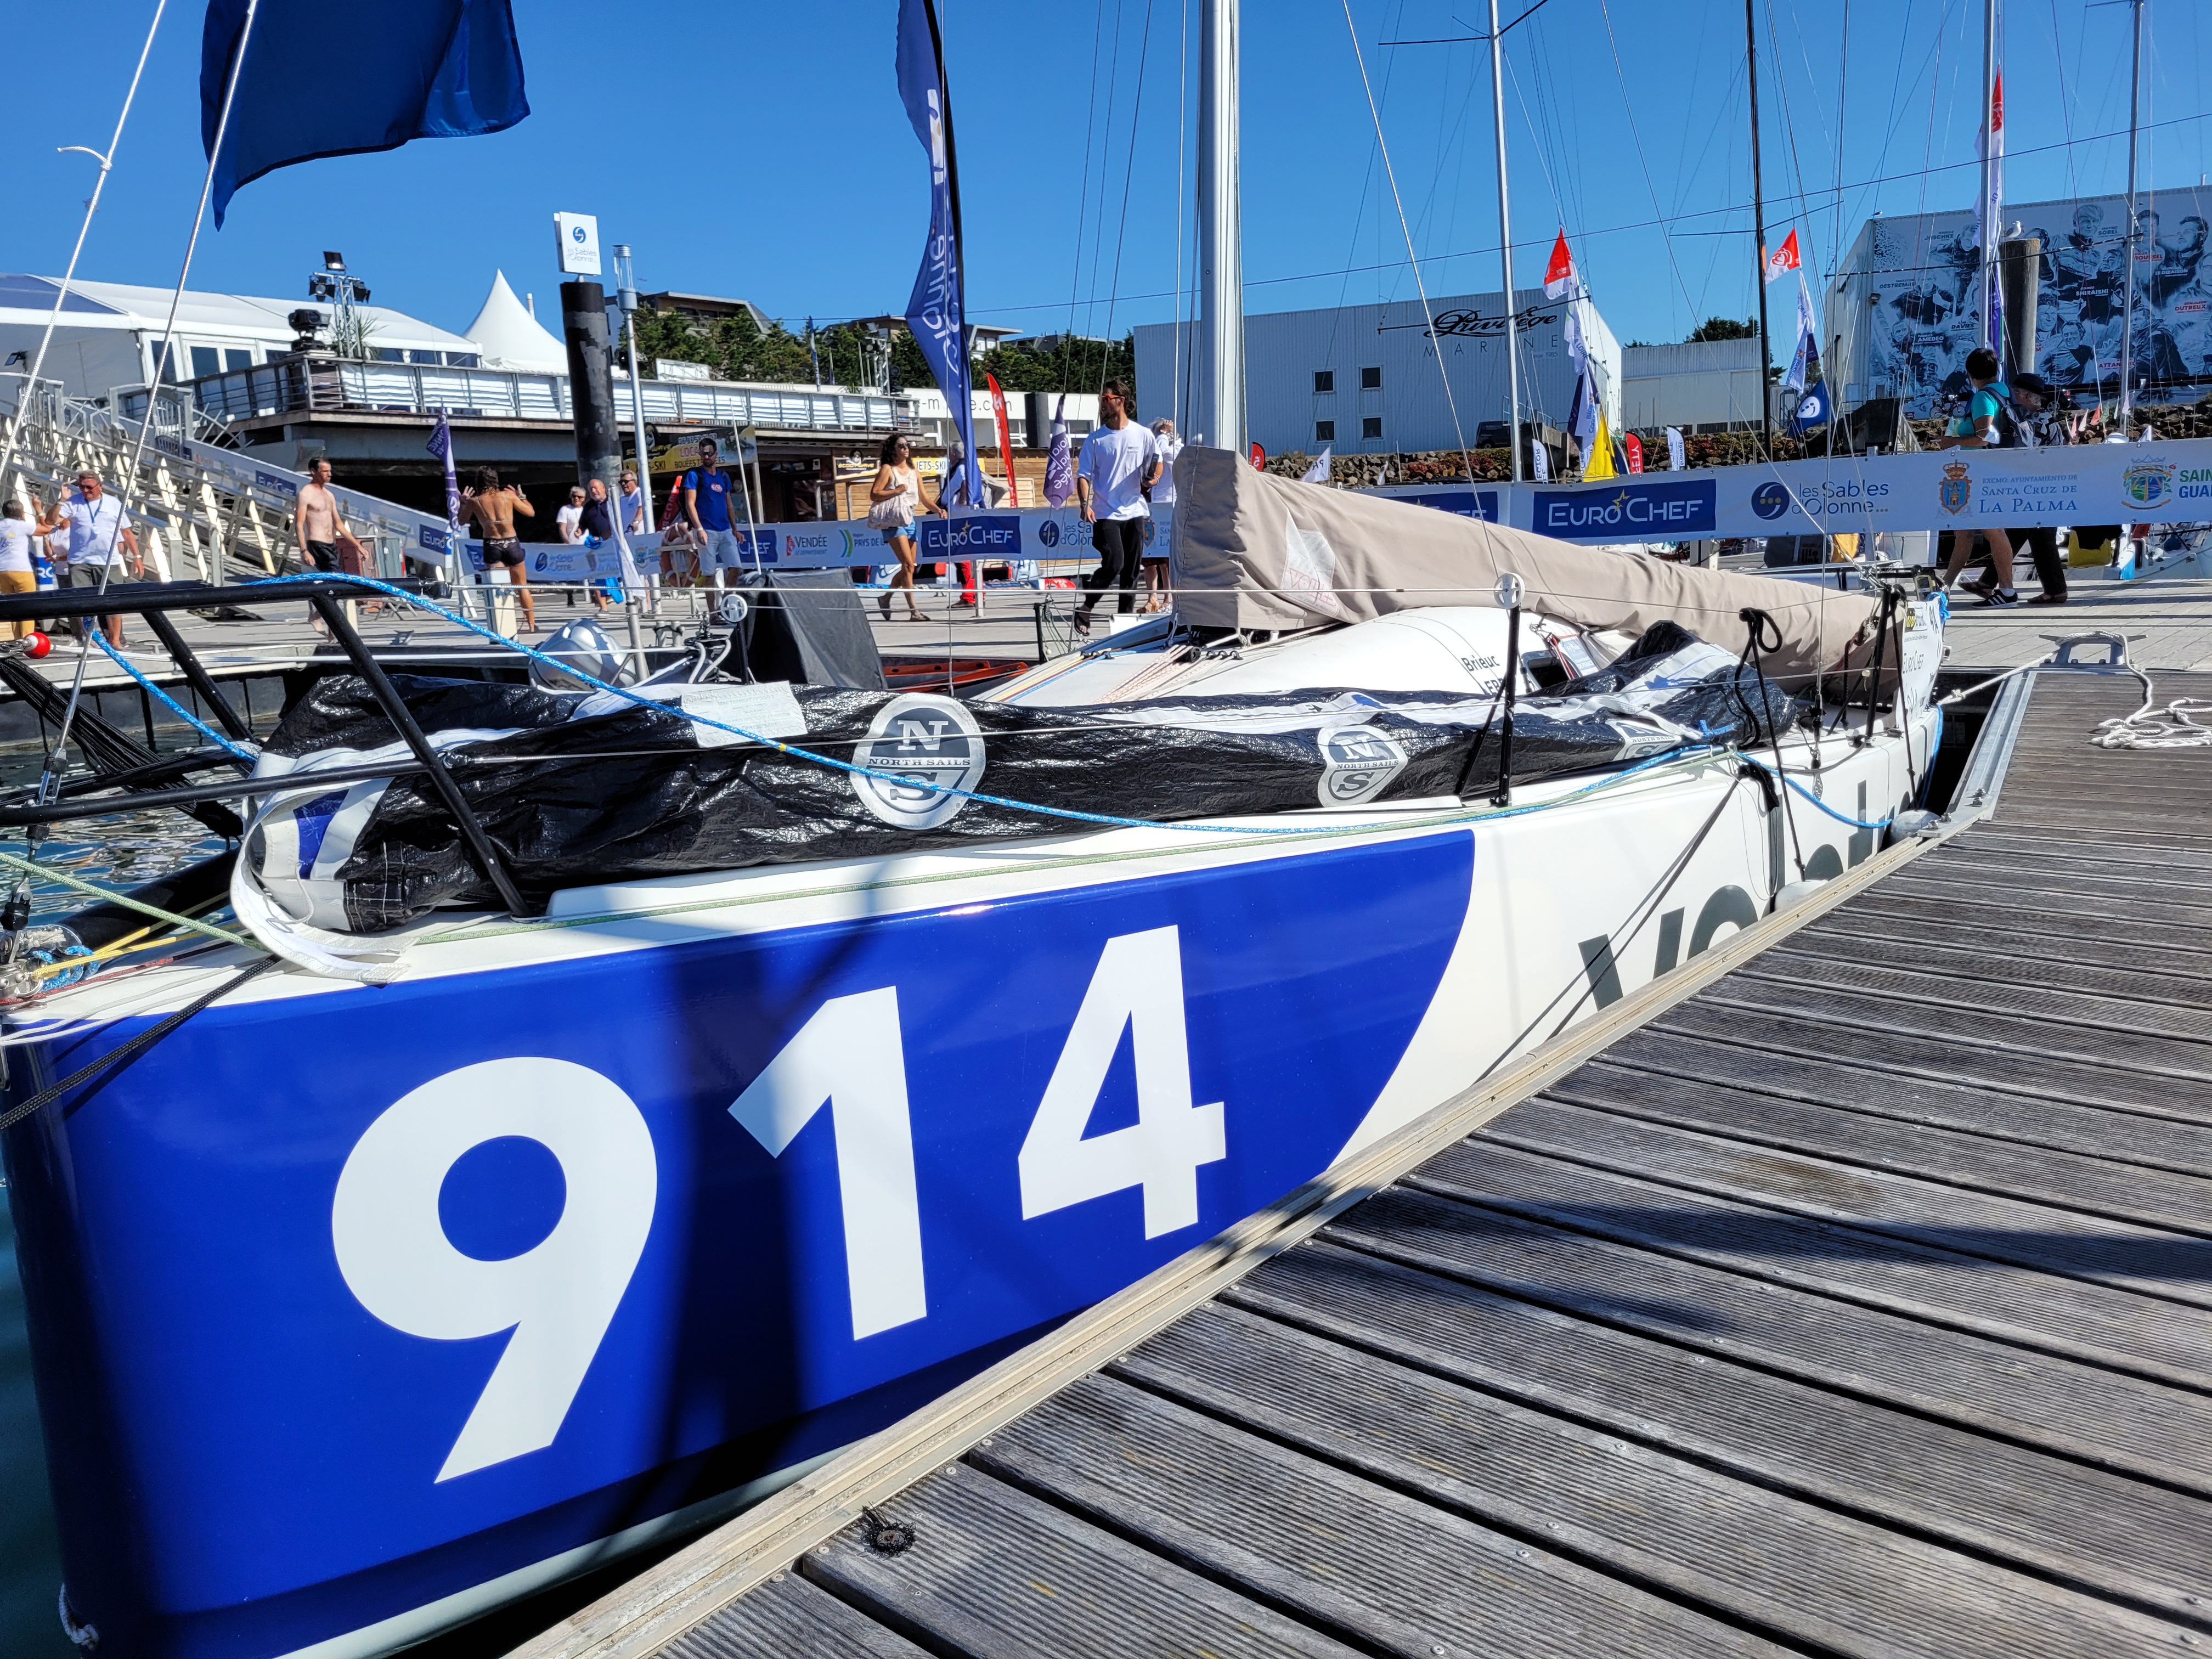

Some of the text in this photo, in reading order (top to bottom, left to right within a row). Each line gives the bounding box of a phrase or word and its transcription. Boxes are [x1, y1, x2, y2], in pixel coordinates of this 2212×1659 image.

[575, 247, 597, 256] Sables
[1424, 335, 1559, 358] MARINE
[680, 446, 700, 458] LOCA
[1799, 479, 1889, 499] les Sables
[1981, 487, 2019, 495] SANTA
[2023, 485, 2057, 494] CRUZ
[1548, 497, 1703, 526] EUROCHEF
[1979, 498, 2078, 513] LA PALMA
[1064, 523, 1076, 533] les
[795, 534, 828, 548] VENDÉE
[871, 538, 880, 546] DE
[928, 528, 1014, 548] EUROCHEF
[1461, 654, 1500, 672] Brieuc
[1336, 772, 1376, 792] S
[331, 925, 1226, 1485] 914
